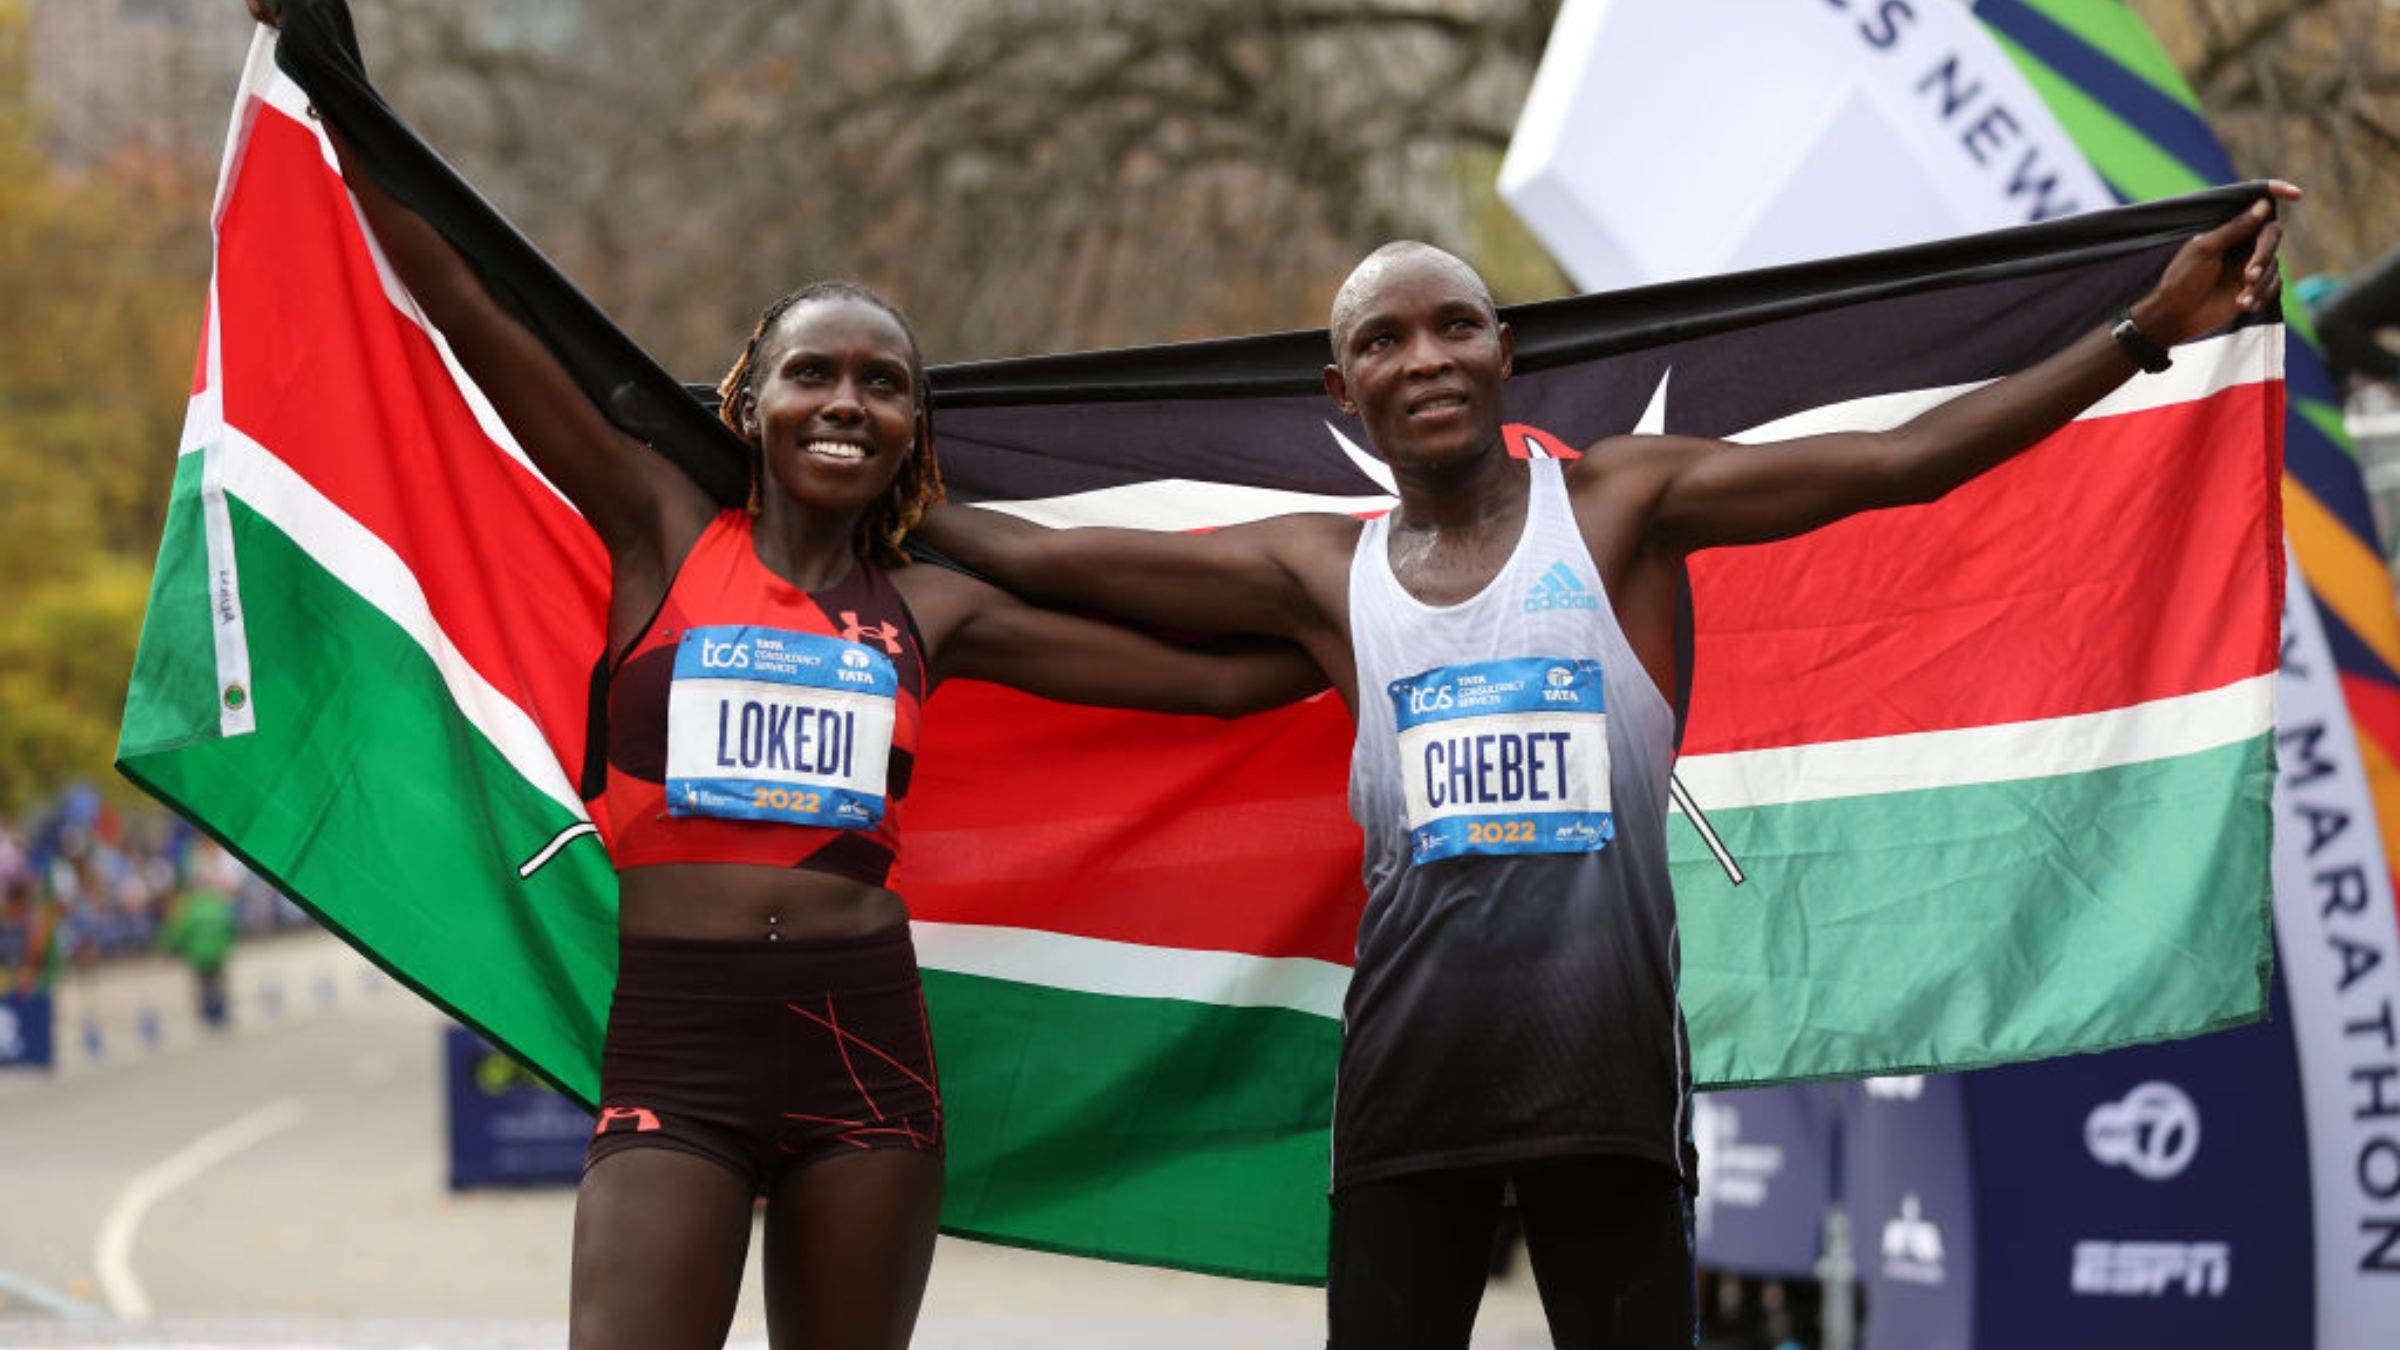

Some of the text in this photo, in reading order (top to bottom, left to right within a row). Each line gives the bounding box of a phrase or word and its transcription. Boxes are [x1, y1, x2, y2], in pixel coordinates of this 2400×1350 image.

[1914, 54, 2082, 224] NEW
[1523, 588, 1600, 614] adidas
[837, 669, 875, 685] TATA
[1541, 689, 1580, 703] TATA
[716, 699, 855, 778] LOKEDI
[1424, 731, 1571, 809] CHEBET
[752, 788, 821, 813] 2022
[1467, 821, 1537, 844] 2022
[2277, 721, 2400, 1275] MARATHON
[2070, 1241, 2231, 1297] ESPN
